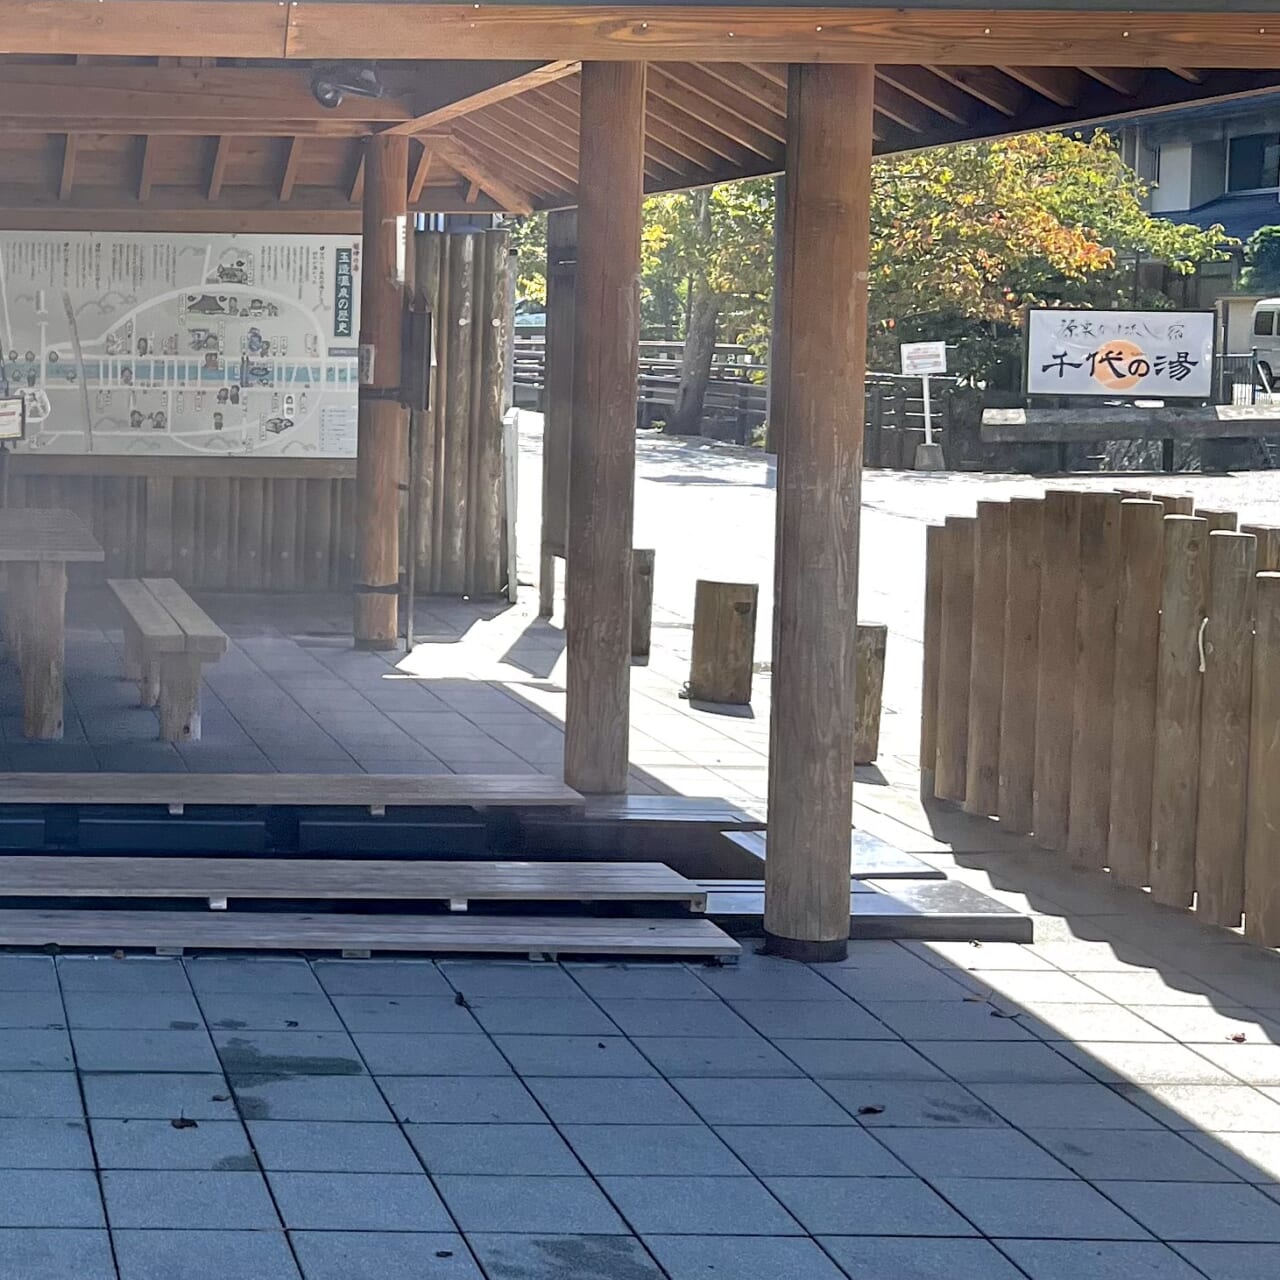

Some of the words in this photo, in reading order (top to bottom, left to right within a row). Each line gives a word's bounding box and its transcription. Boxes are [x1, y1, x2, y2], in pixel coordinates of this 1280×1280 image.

[337, 252, 350, 333] 玉造温泉の歴史
[1041, 350, 1199, 381] 千代の湯
